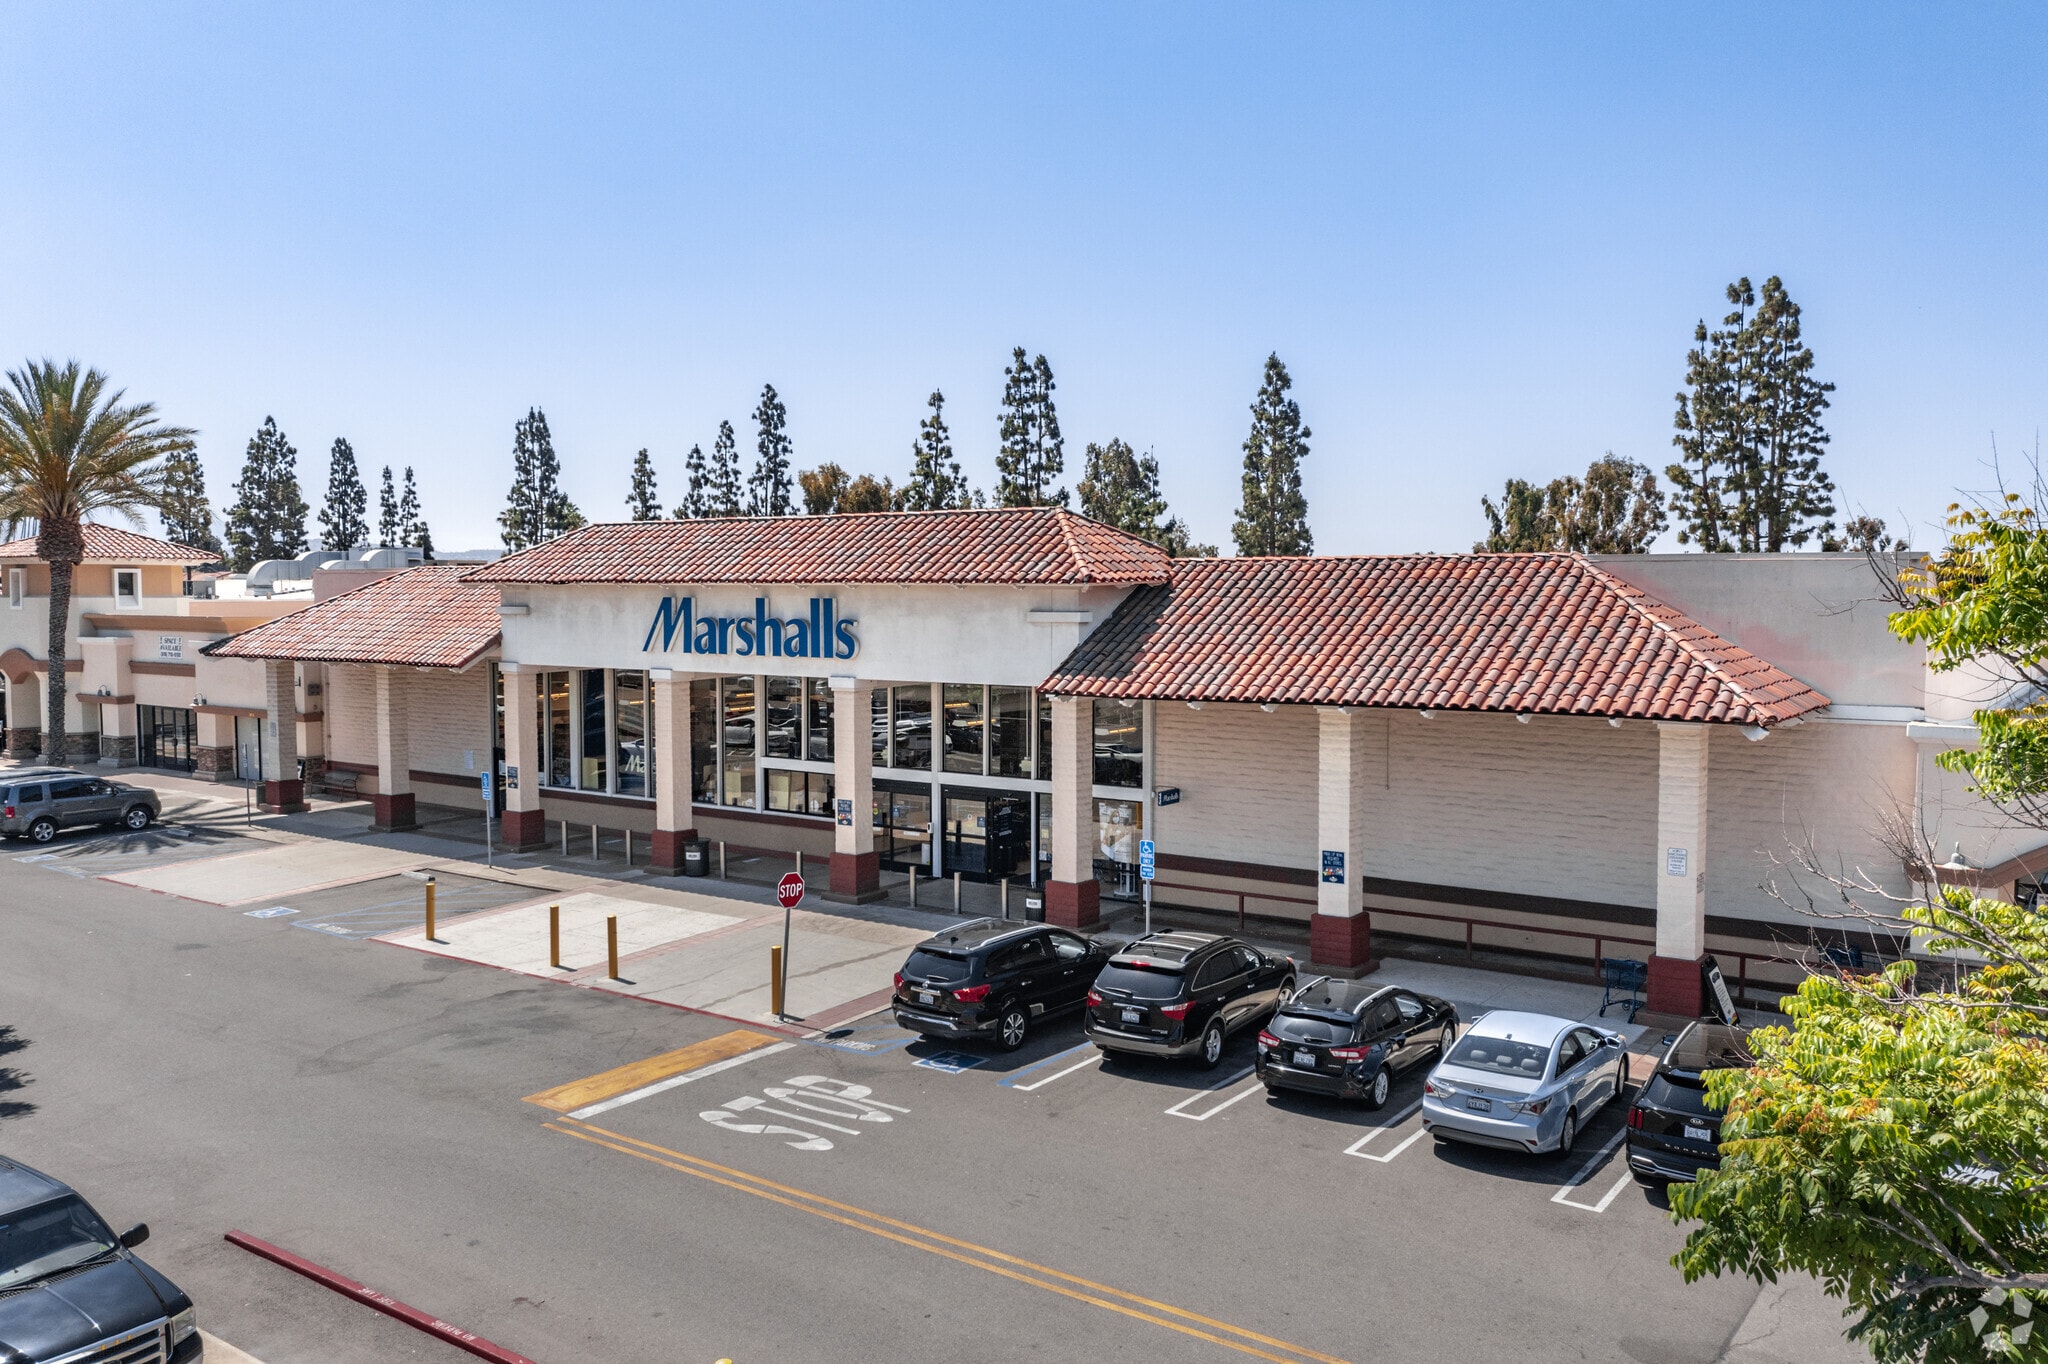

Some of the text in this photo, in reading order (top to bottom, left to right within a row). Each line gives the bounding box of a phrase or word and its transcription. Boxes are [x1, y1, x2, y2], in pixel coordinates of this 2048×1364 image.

[642, 596, 858, 660] Marshalls
[779, 883, 803, 898] STOP
[699, 1075, 912, 1150] STOP
[1690, 1118, 1704, 1126] KIA
[1665, 1143, 1721, 1157] SORENT
